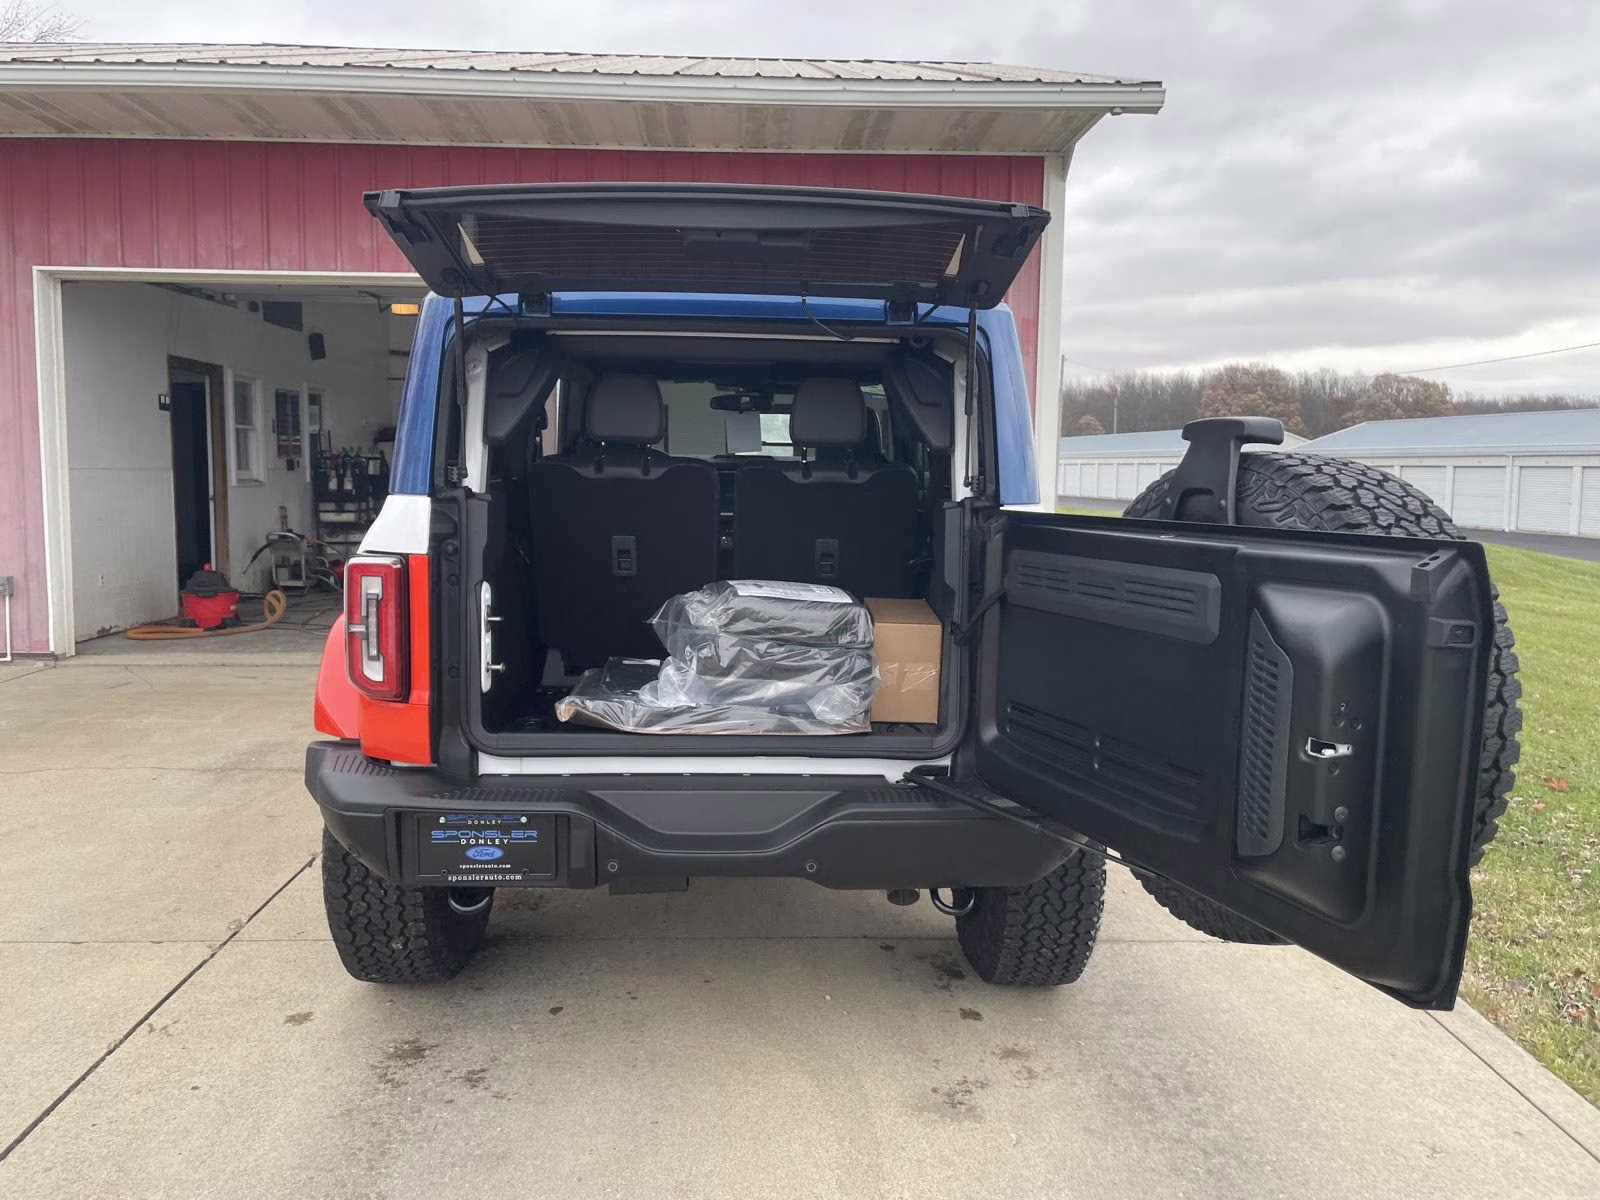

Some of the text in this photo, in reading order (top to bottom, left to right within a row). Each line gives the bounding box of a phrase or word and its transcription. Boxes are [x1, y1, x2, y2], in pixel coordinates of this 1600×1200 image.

[431, 830, 538, 839] SPONSLER
[472, 848, 496, 858] Ford
[447, 874, 522, 882] sponslerauto.com
